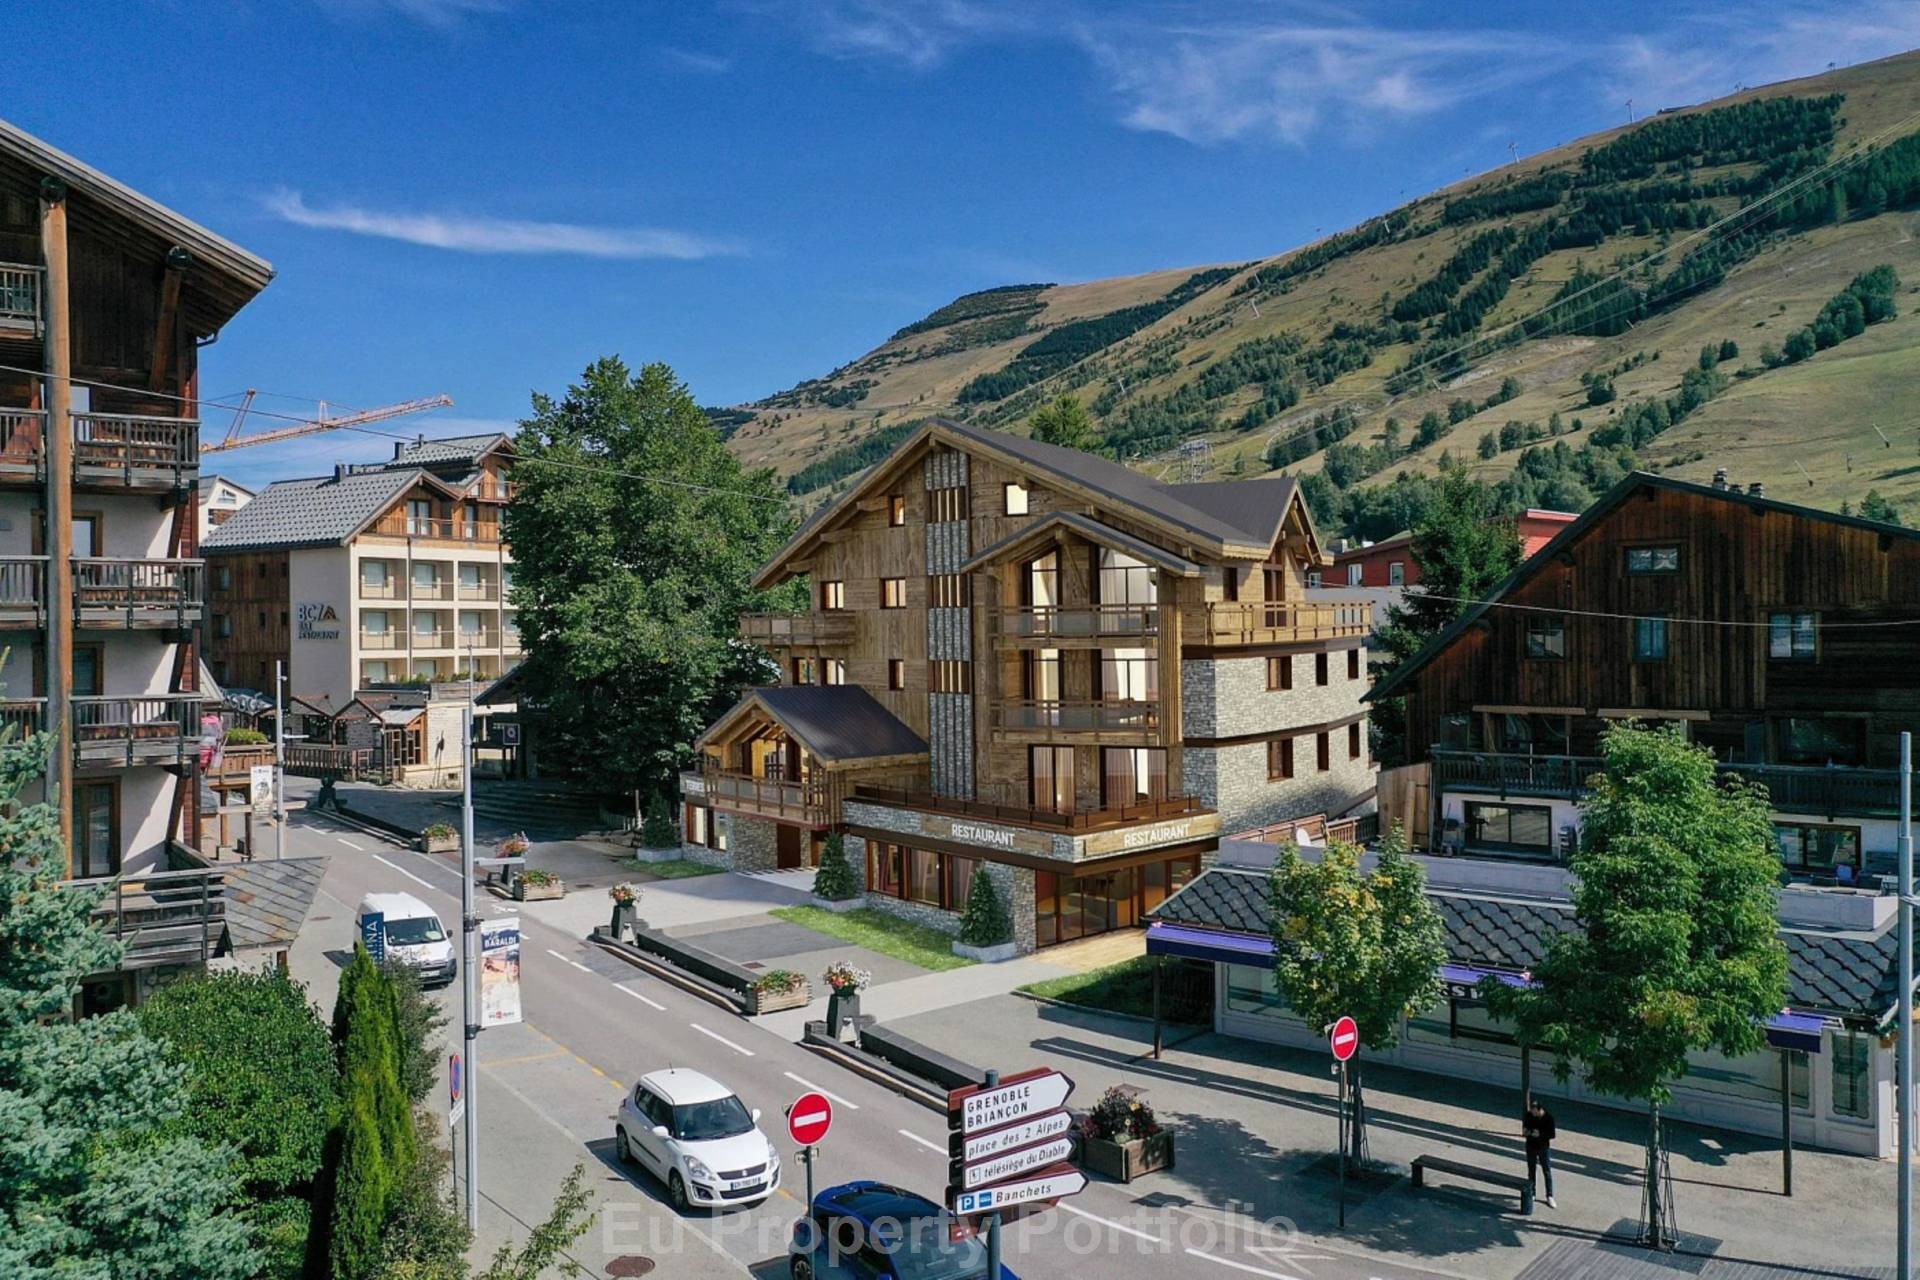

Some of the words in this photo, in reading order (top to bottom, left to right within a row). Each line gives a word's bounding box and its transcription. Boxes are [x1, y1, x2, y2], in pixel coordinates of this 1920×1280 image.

[951, 823, 1016, 847] RESTAURANT
[1123, 823, 1190, 847] RESTAURANT
[967, 1086, 1030, 1112] GRENOBLE
[967, 1101, 1028, 1127] BRIANÇON
[968, 1140, 997, 1158] place
[1002, 1132, 1020, 1145] des
[1025, 1127, 1031, 1139] 2
[1036, 1120, 1063, 1136] Alpes
[984, 1160, 1024, 1178] télésiège
[1026, 1153, 1037, 1163] du
[1039, 1145, 1065, 1161] Diable
[996, 1185, 1052, 1203] Banchets
